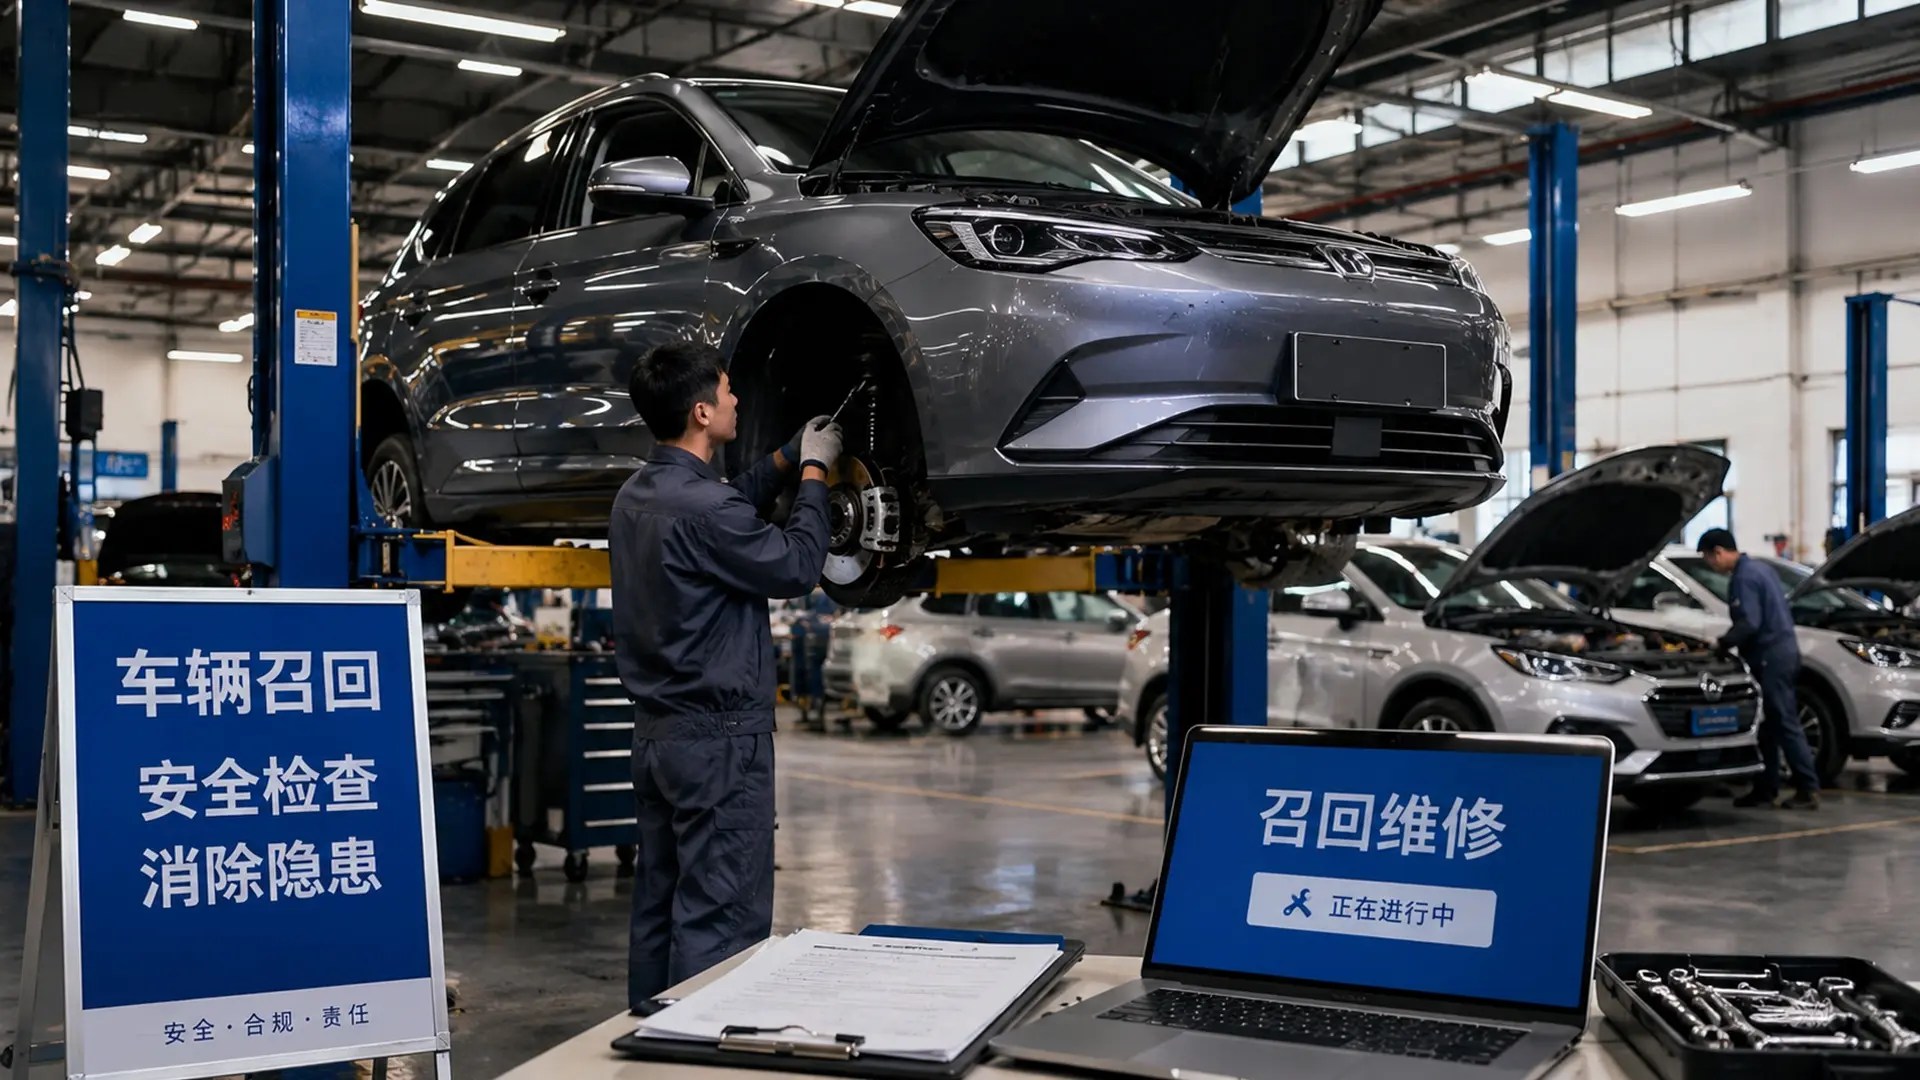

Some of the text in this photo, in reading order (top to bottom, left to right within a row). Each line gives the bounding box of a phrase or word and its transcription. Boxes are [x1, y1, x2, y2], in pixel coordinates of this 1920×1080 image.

[116, 648, 381, 717] 车辆召回
[139, 753, 378, 821] 安全检查
[1259, 789, 1507, 860] 召回维修
[140, 836, 382, 908] 消除隐患
[1329, 895, 1455, 928] 正在进行中
